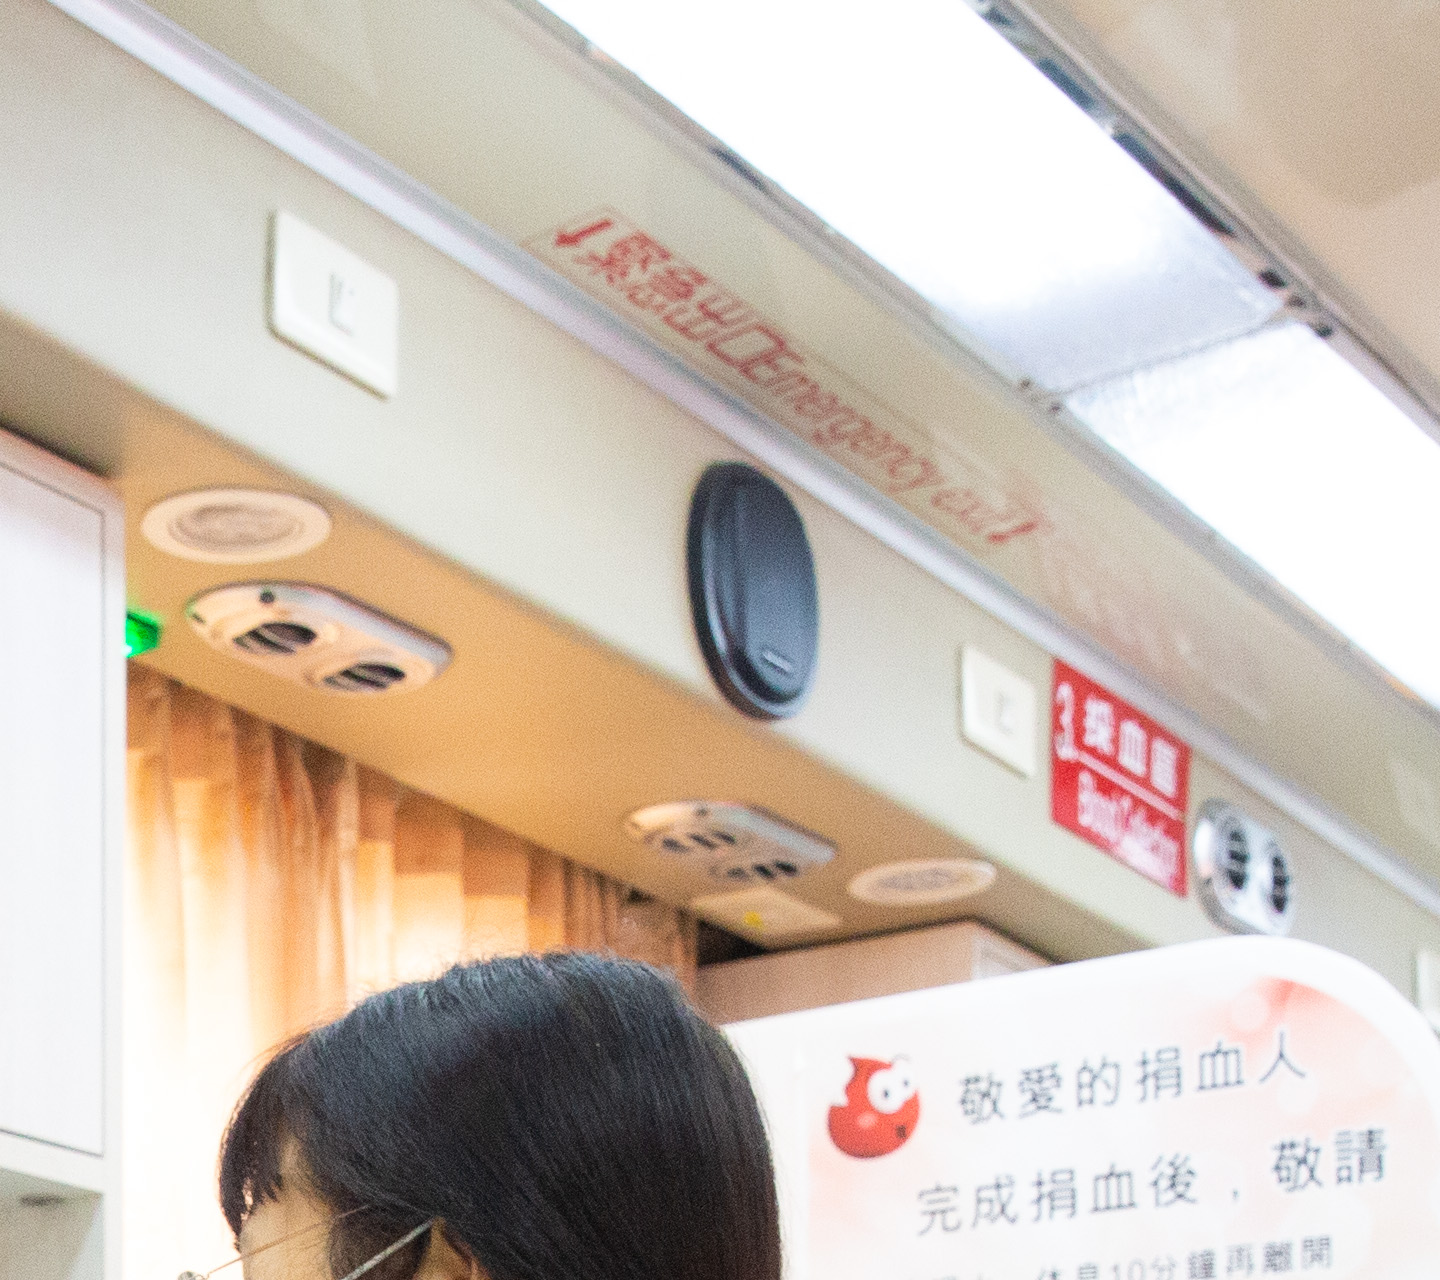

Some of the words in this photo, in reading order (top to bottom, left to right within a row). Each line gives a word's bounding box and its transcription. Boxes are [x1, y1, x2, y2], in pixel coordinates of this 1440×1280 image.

[958, 1030, 1307, 1125] 敬愛的捐血人
